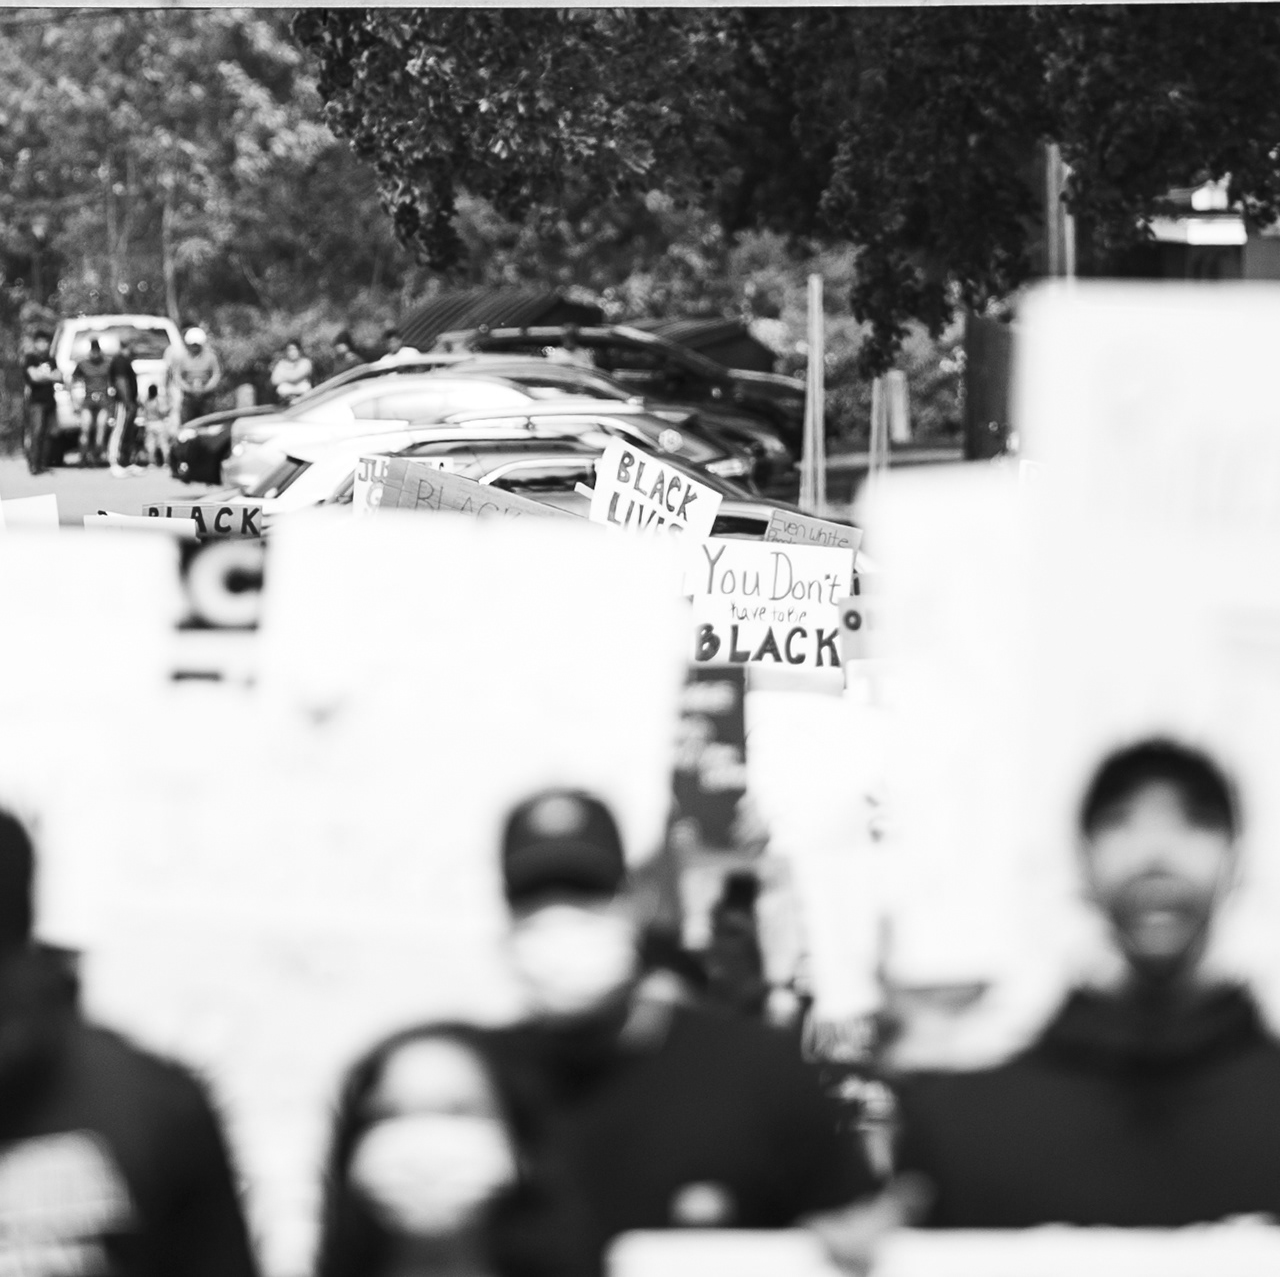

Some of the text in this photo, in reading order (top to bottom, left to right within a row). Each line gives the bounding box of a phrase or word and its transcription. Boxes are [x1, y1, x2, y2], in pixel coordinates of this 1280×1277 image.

[616, 449, 698, 523] BLACK
[770, 509, 849, 549] Even white
[702, 543, 842, 606] You Don't
[730, 601, 766, 621] have
[694, 622, 842, 668] BLACK
